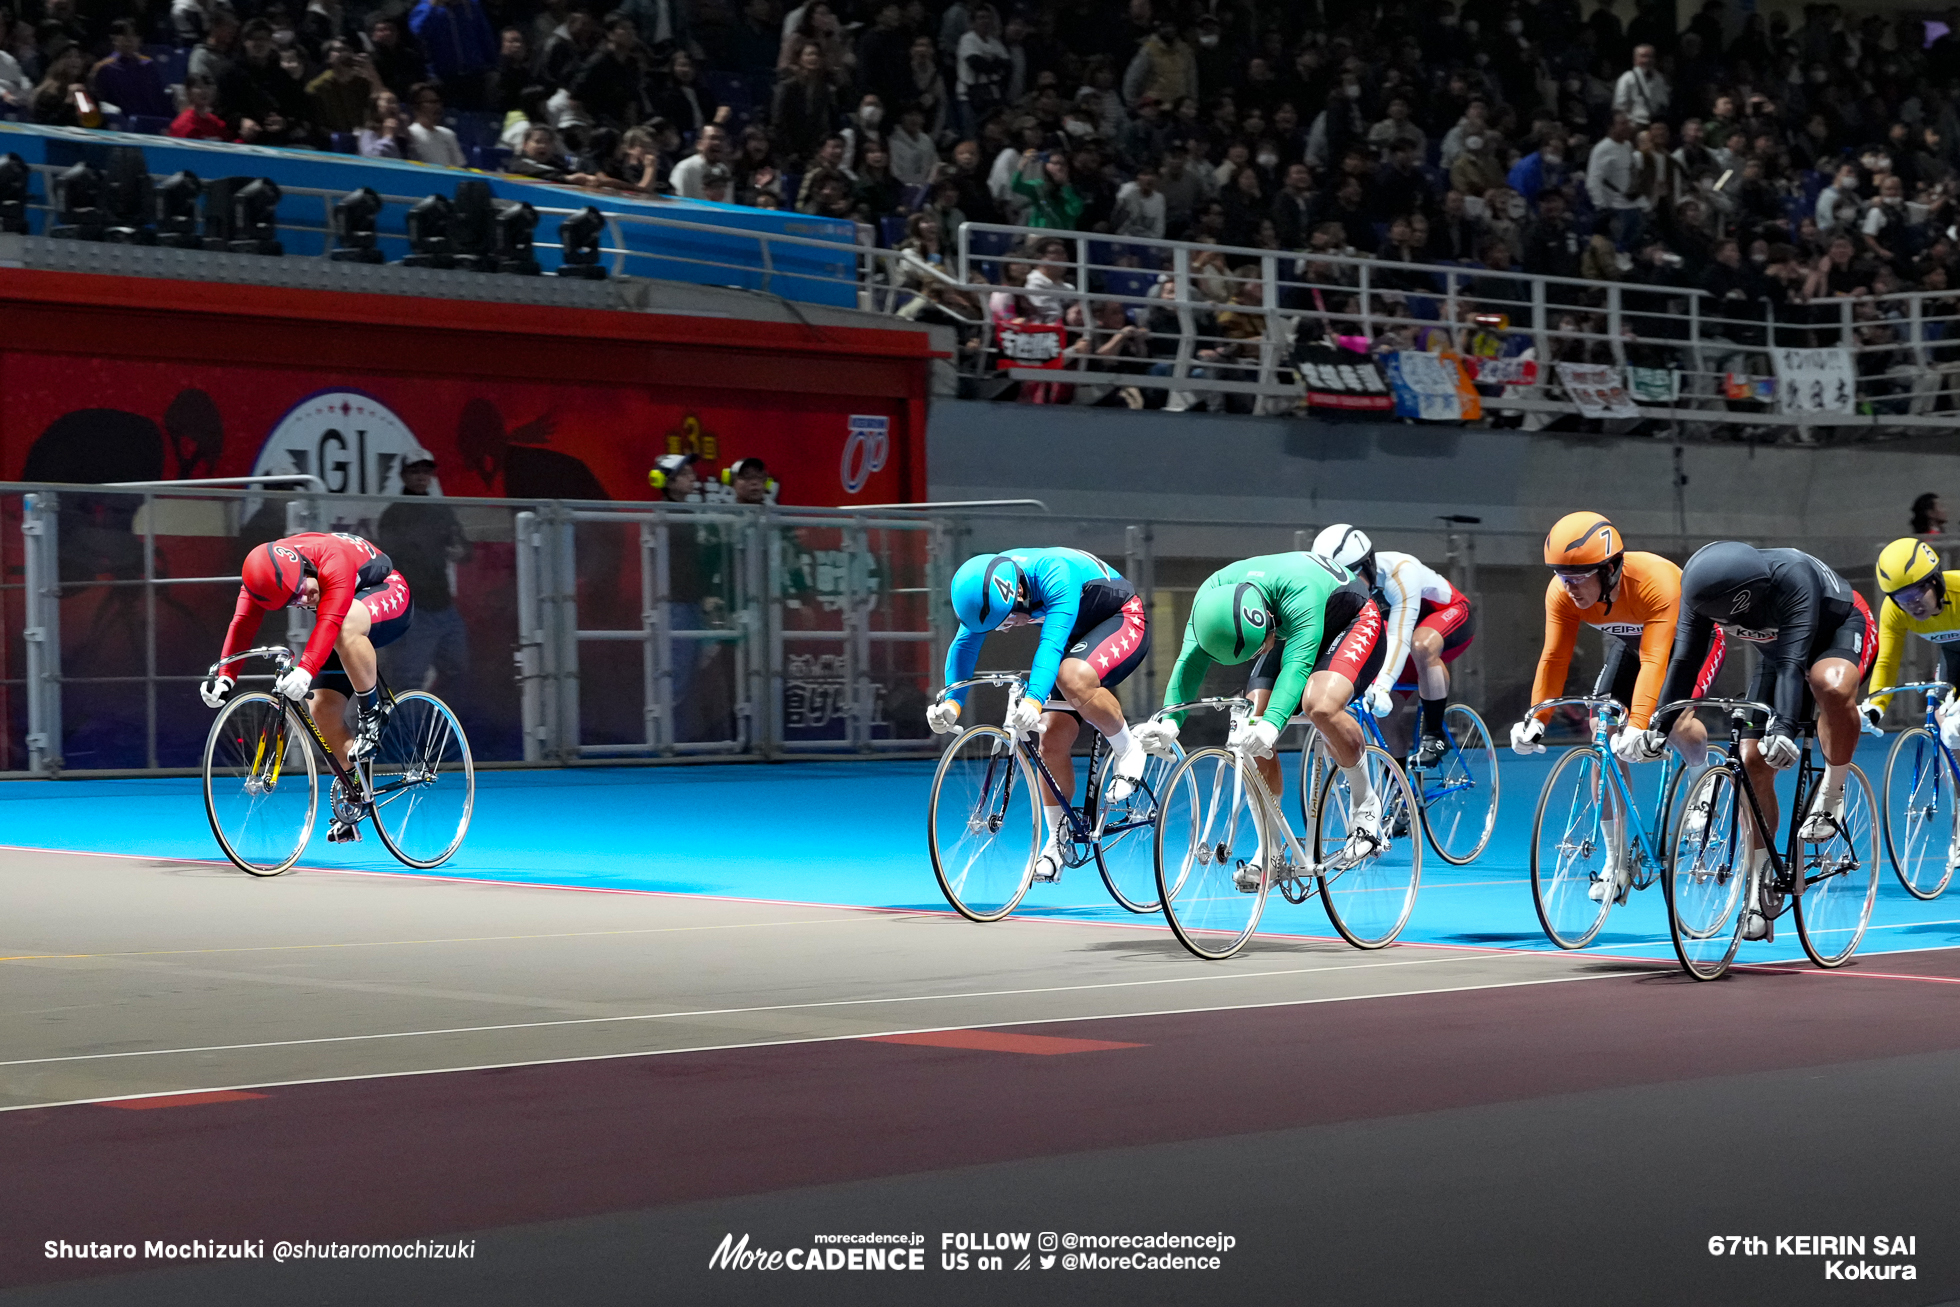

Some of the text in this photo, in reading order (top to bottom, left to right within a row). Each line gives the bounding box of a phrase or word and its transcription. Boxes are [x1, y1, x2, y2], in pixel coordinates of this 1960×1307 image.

[274, 545, 299, 563] 3
[1353, 532, 1366, 552] 1
[1600, 527, 1613, 557] 7
[1920, 541, 1939, 565] 5
[993, 574, 1017, 604] 4
[1730, 589, 1752, 615] 2
